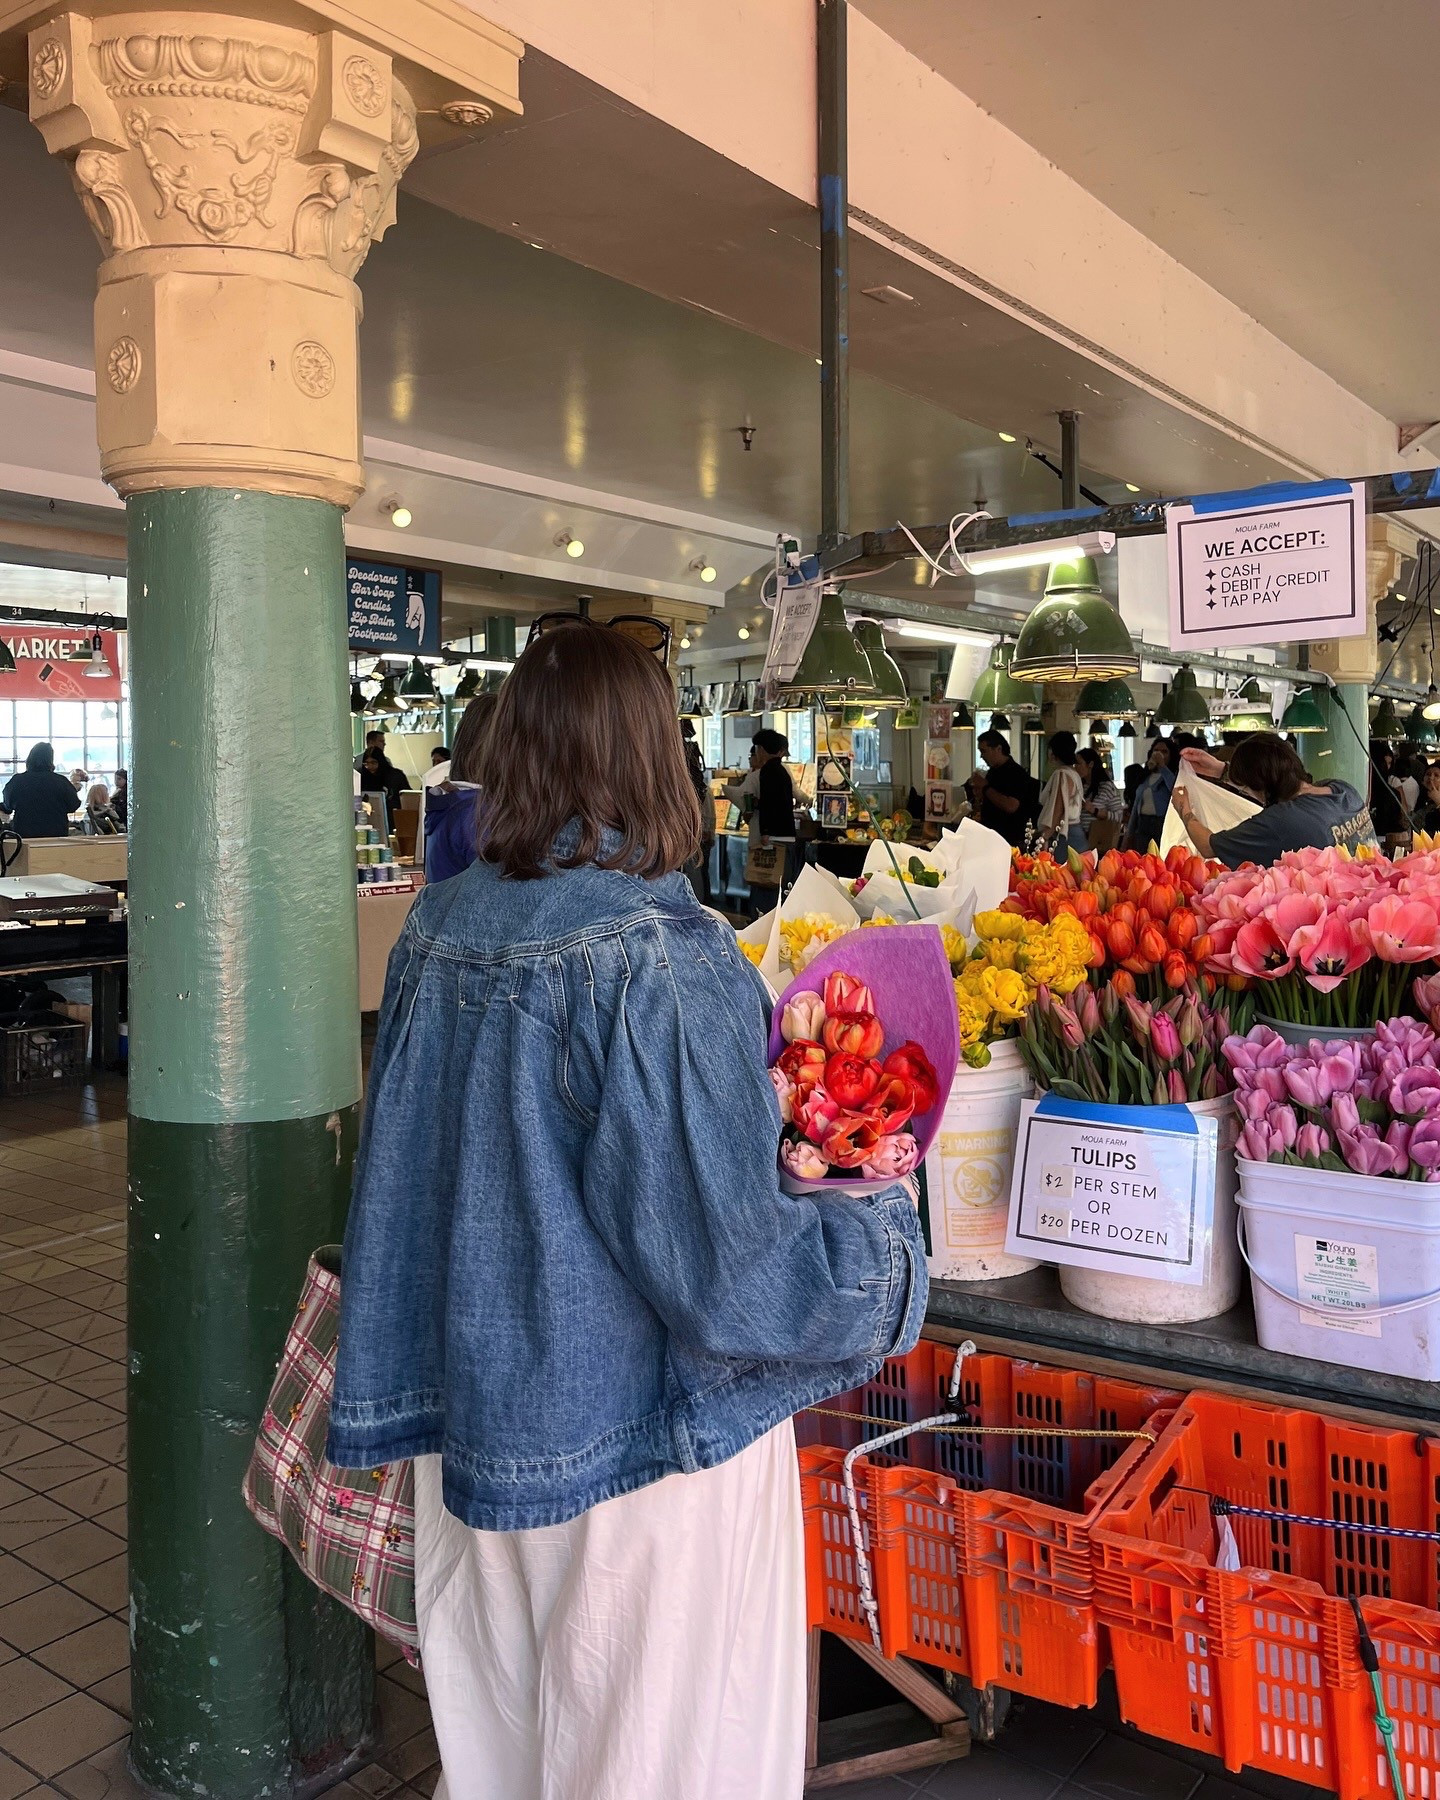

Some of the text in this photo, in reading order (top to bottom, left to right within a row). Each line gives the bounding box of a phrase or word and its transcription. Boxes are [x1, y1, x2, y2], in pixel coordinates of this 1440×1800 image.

[1235, 521, 1280, 533] MOUA FARM
[1205, 530, 1326, 558] WE ACCEPT:
[348, 567, 398, 585] Deodorant
[1221, 562, 1261, 579] CASH
[1221, 570, 1330, 593] DEBIT / CREDIT
[351, 582, 396, 600] Bar Soap
[1221, 590, 1281, 608] TAP PAY
[12, 607, 22, 616] 34
[355, 597, 392, 612] Candles
[350, 611, 396, 627] Lip Balm
[348, 625, 398, 642] Toothpaste
[955, 1136, 1009, 1151] WARNING
[1081, 1134, 1127, 1147] MOUA FARM
[1070, 1146, 1137, 1170] TULIPS
[1045, 1173, 1157, 1199] $2 PER STEM
[1087, 1200, 1111, 1216] OR
[1040, 1213, 1168, 1246] $20 PER DOZEN
[1327, 1242, 1356, 1256] Young
[1327, 1289, 1348, 1297] WHITE
[1341, 1299, 1366, 1309] 20LBS
